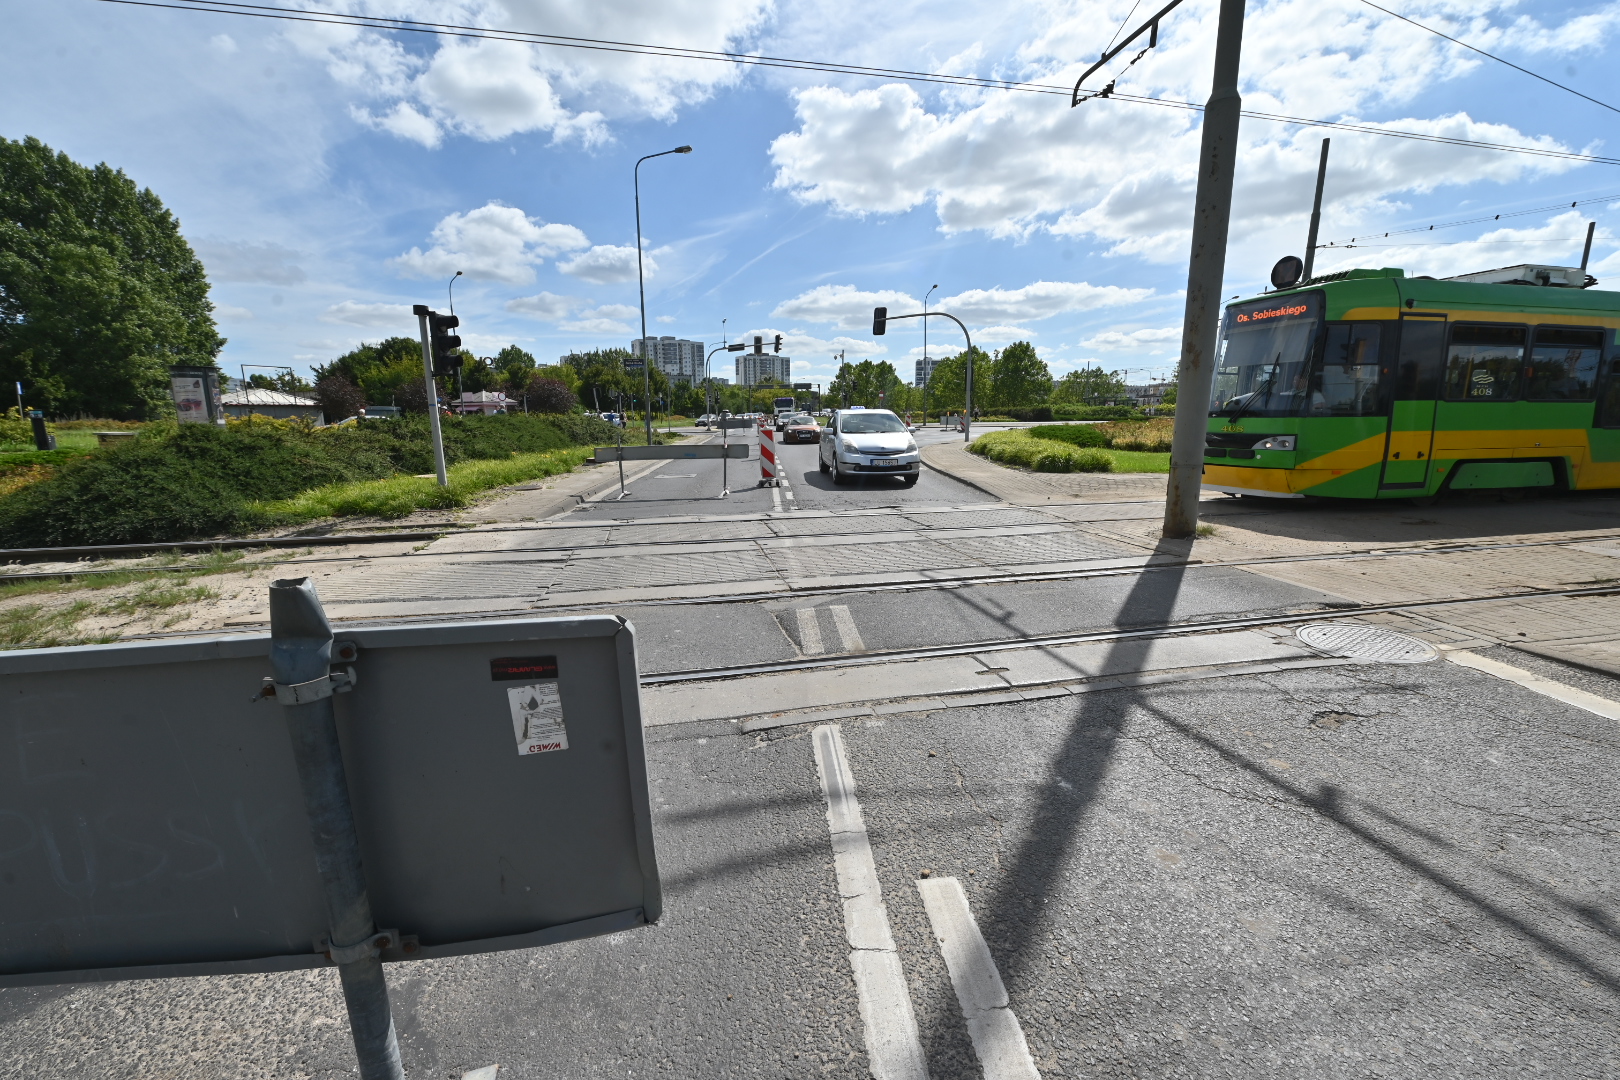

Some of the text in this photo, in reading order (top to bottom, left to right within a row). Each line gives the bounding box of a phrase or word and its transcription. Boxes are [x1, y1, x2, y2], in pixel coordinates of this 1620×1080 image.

[1237, 305, 1308, 323] Os. Sobieskiego
[1471, 388, 1493, 396] 408
[1220, 425, 1244, 433] 408
[529, 742, 561, 753] WIMED
